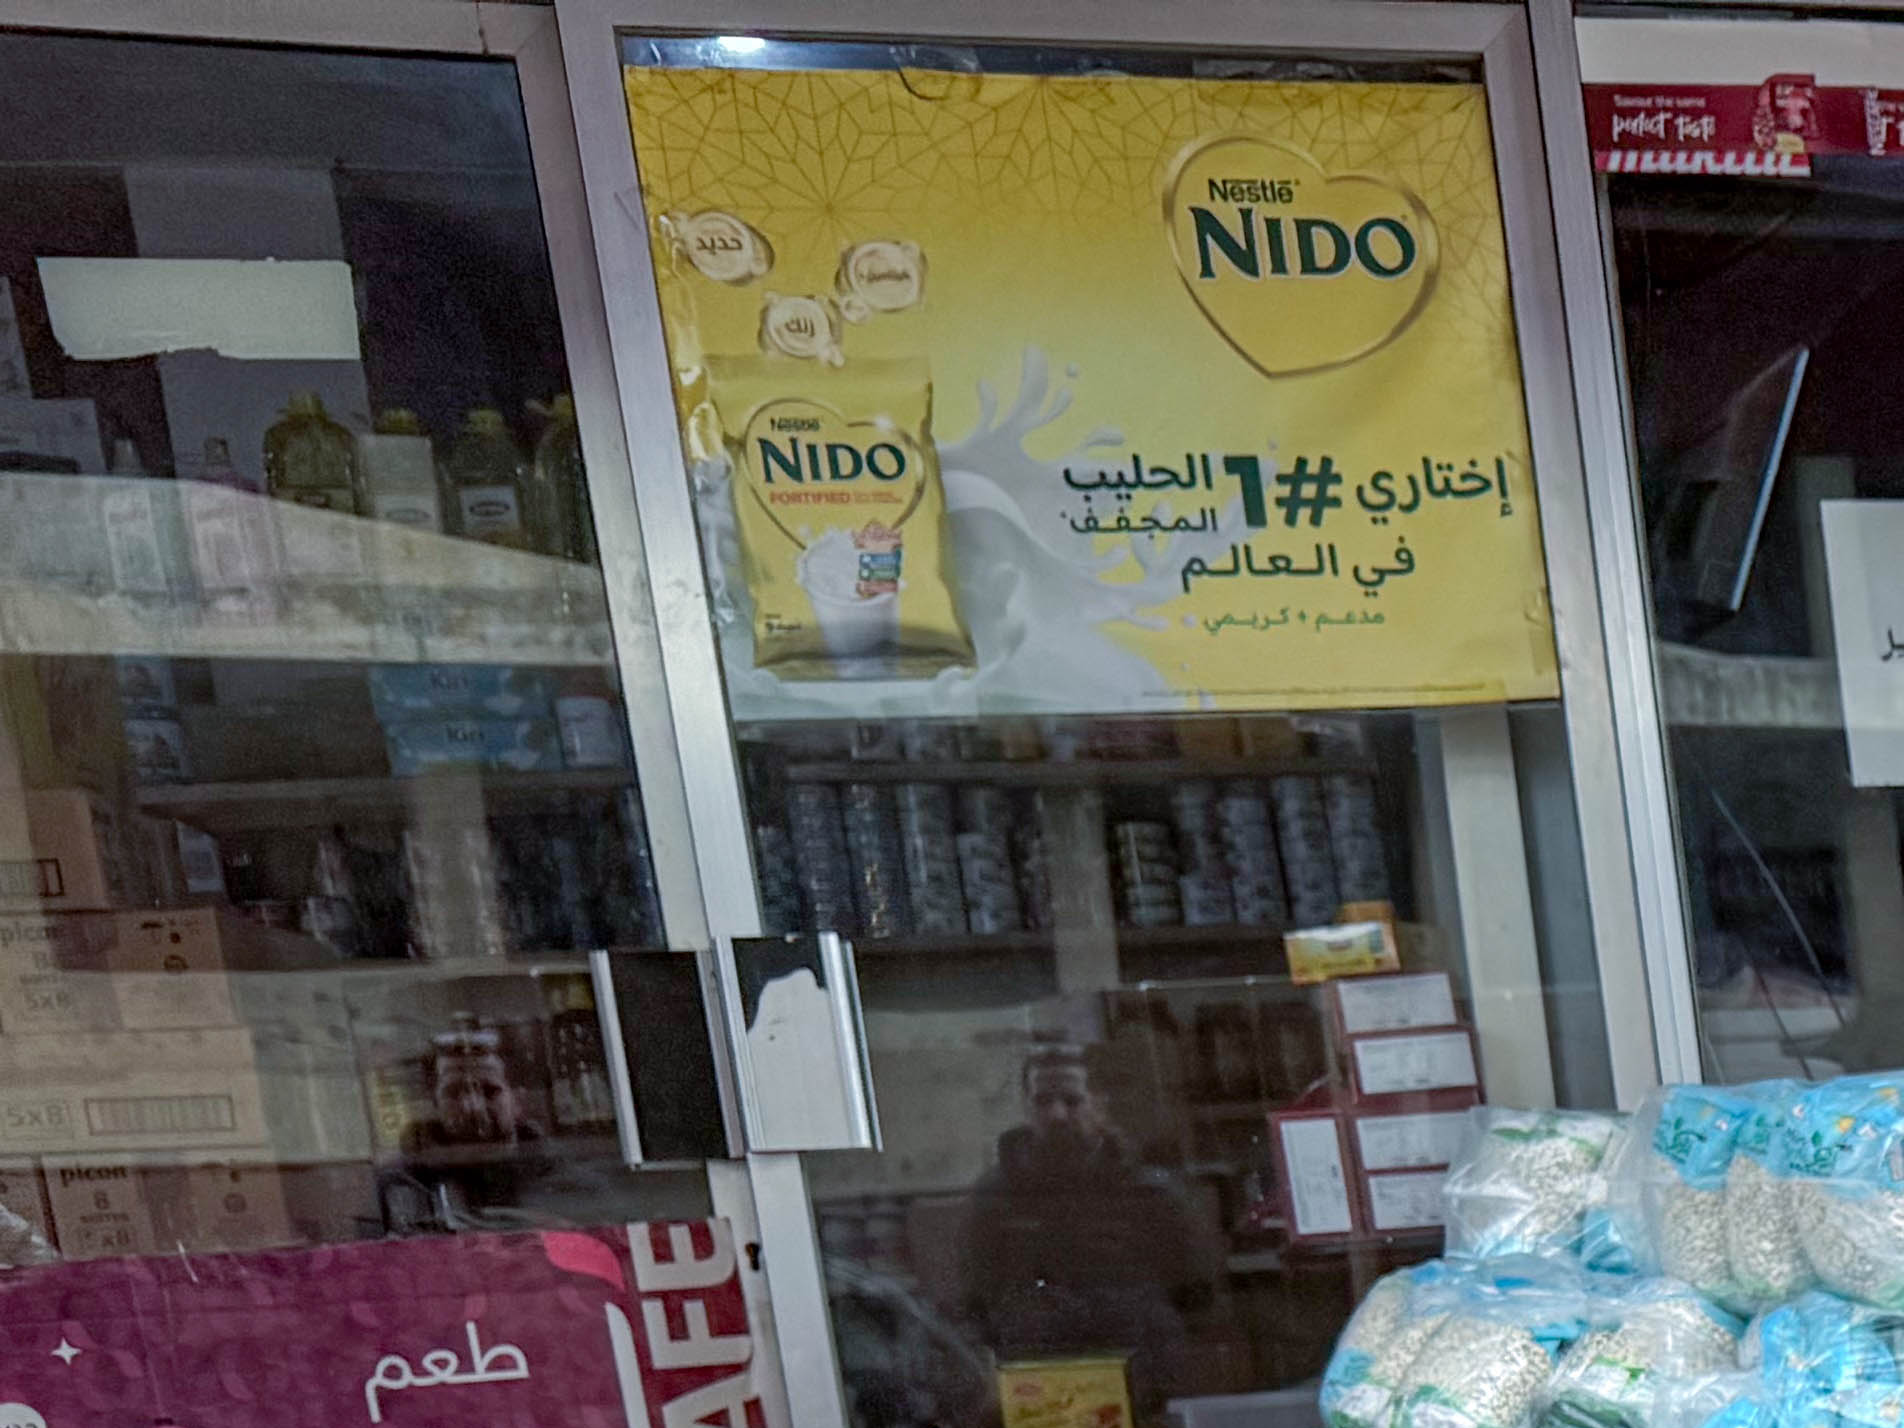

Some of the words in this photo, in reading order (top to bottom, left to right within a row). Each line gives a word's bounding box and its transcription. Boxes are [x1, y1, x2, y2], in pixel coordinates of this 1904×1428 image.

[696, 236, 743, 256] حديد
[1188, 206, 1416, 279] NIDO
[757, 437, 906, 484] NIDO
[1062, 452, 1213, 503] الحليب
[1355, 455, 1514, 526] إختاري
[1069, 507, 1218, 542] المجفف
[1180, 543, 1340, 593] العالم
[1352, 535, 1416, 599] في
[365, 1319, 530, 1424] طعم
